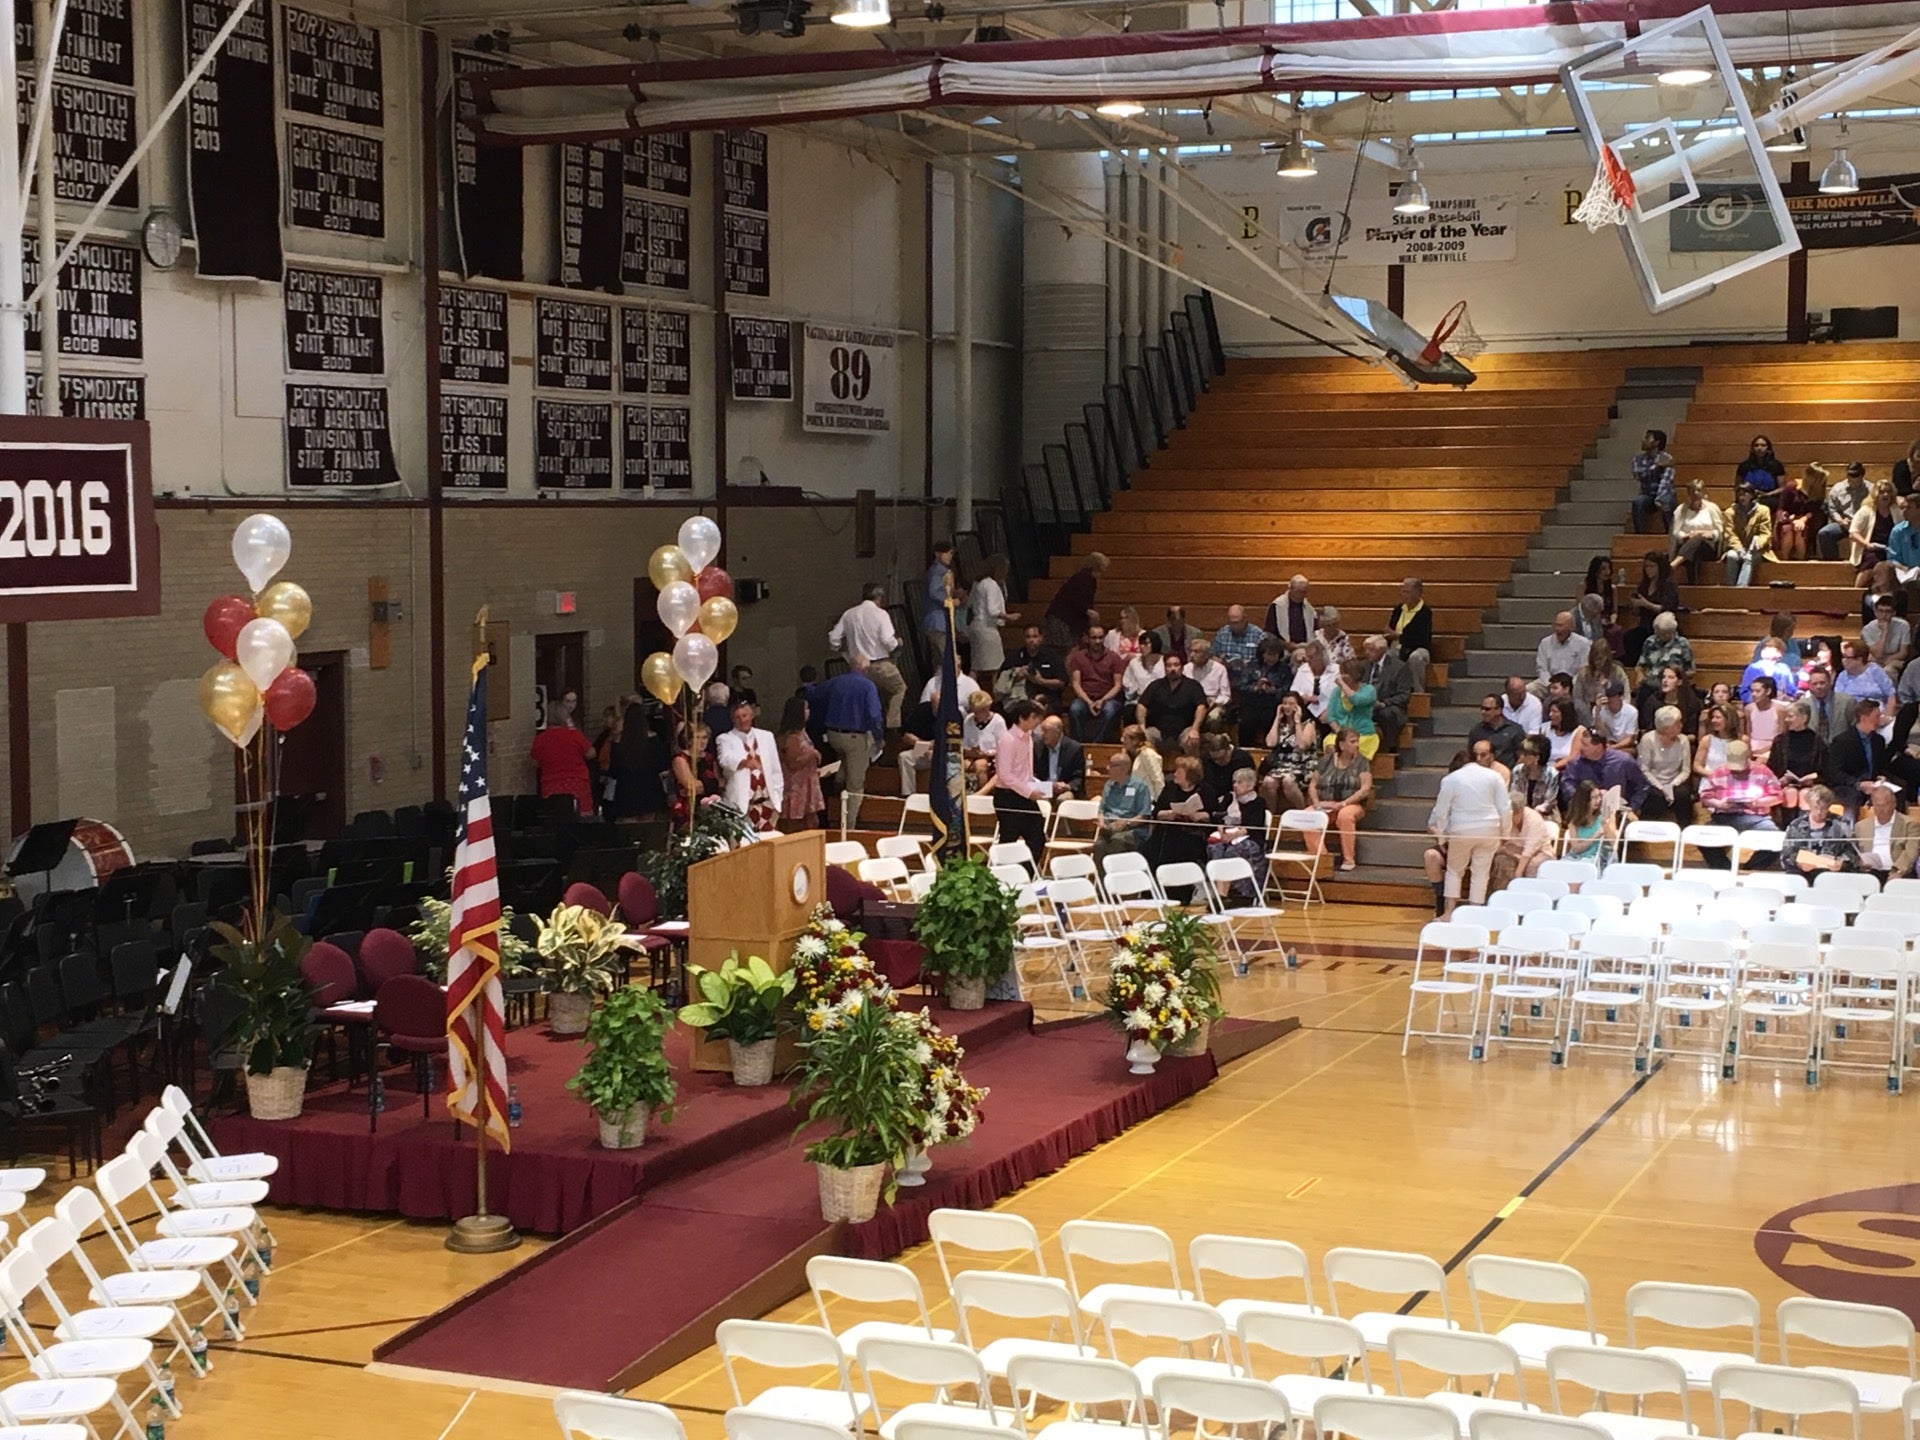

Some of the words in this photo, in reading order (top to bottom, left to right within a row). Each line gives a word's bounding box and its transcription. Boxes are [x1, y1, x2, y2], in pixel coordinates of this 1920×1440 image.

[287, 8, 375, 50] PORTSMOUTH
[66, 33, 122, 65] FINALIST
[325, 40, 374, 70] LACROSSE
[54, 54, 91, 75] 2006
[17, 80, 129, 119] POTSMOUTH
[288, 73, 319, 98] STATE
[326, 82, 380, 110] CHAMPIONS
[66, 110, 128, 142] LACROSSE
[193, 103, 218, 127] 2011
[54, 133, 76, 157] IV.
[87, 138, 104, 161] III
[193, 128, 220, 152] 2013
[292, 126, 378, 161] PORTSMOUTH
[634, 139, 665, 162] CLSS
[53, 157, 121, 185] AMPIONS
[329, 154, 377, 181] LACROSSE
[57, 180, 95, 200] 2007
[317, 171, 343, 195] DIV.
[290, 188, 322, 212] STATE
[329, 194, 381, 222] CHAMPIONS
[1815, 194, 1897, 210] MONTVILLE
[323, 214, 352, 231] 2013
[1392, 214, 1425, 226] State
[1812, 220, 1837, 229] PLAYER
[1850, 219, 1864, 227] THE
[1866, 216, 1883, 226] YEAR
[1365, 227, 1416, 243] Player
[1420, 226, 1437, 239] of
[1440, 224, 1467, 238] the
[1471, 223, 1508, 237] Year
[634, 235, 665, 256] CLSS
[1405, 240, 1465, 253] 2008-2009
[1398, 253, 1417, 264] MIKE
[1422, 252, 1468, 262] MONTVILLE
[70, 266, 134, 295] LACROSSE
[289, 270, 377, 298] PORTSMOUTH
[91, 293, 109, 315] III
[541, 299, 609, 324] PORTSMOUTH
[70, 313, 137, 340] CHAMPIONS
[306, 313, 350, 336] CLASS
[569, 320, 606, 342] BASEBALL
[734, 319, 789, 339] PORTSMOUTH
[63, 336, 100, 354] 2008
[295, 333, 325, 354] STATE
[333, 336, 375, 358] FINALIST
[442, 326, 479, 348] CLASS
[553, 337, 588, 358] CLASS
[460, 347, 505, 368] CHAMPIONS
[540, 354, 564, 374] STATE
[569, 357, 611, 377] CHAMPIONS
[636, 345, 668, 364] CLSS
[734, 368, 755, 385] STATE
[829, 346, 871, 401] 89
[293, 387, 381, 410] PORTSMOUTH
[323, 408, 386, 430] BASKETBALL
[541, 402, 609, 422] PORTSMOUTH
[304, 428, 357, 450] DIVISION
[546, 421, 603, 440] SOFTBALL
[442, 434, 481, 454] CLASS
[297, 449, 326, 469] STATE
[333, 449, 380, 469] FINALIST
[460, 454, 505, 473] CHAMPIONS
[538, 455, 564, 474] STATE
[569, 457, 611, 475] CHAMPIONS
[626, 458, 647, 475] STATE
[323, 470, 353, 483] 2013
[0, 479, 112, 557] 2016
